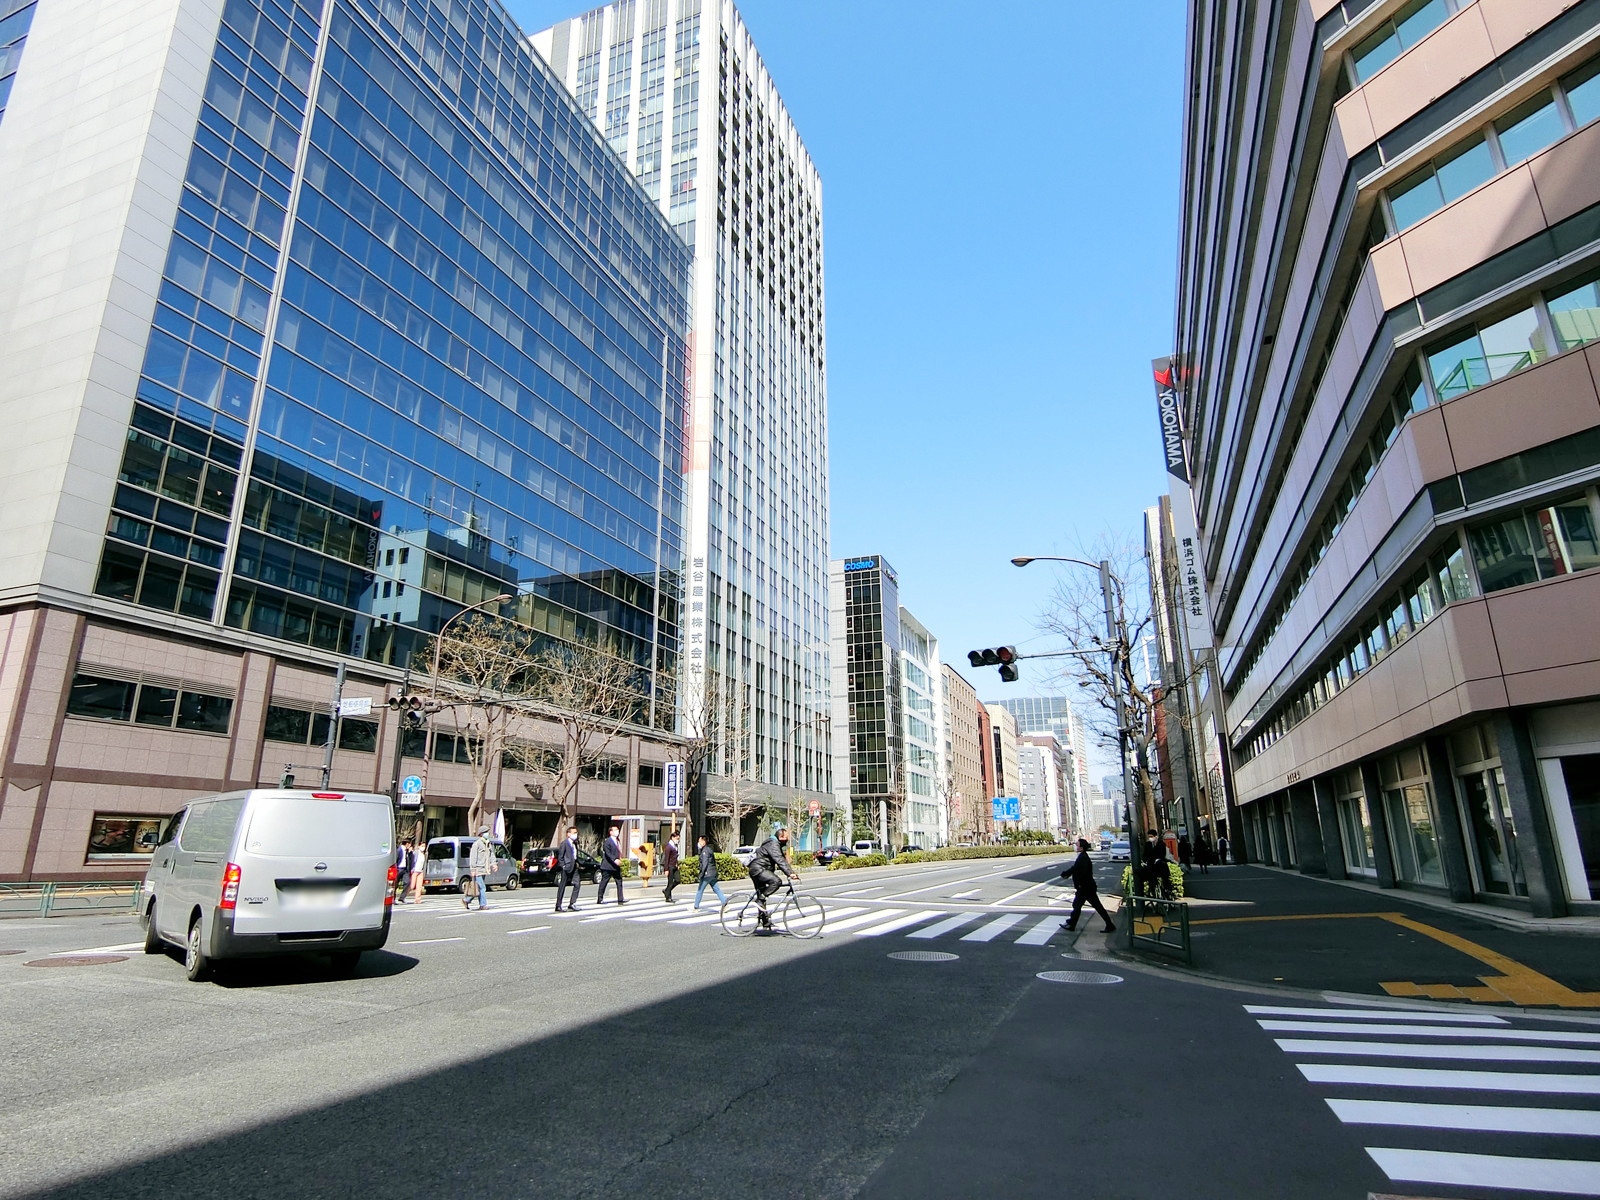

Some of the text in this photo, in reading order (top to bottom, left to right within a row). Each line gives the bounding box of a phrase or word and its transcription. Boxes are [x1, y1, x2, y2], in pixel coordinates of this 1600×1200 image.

[1159, 389, 1182, 468] YOKOHAMA
[844, 560, 875, 571] COSMO
[1183, 537, 1202, 616] 横浜ゴム株式会社
[690, 557, 704, 674] 岩谷産業株式会社
